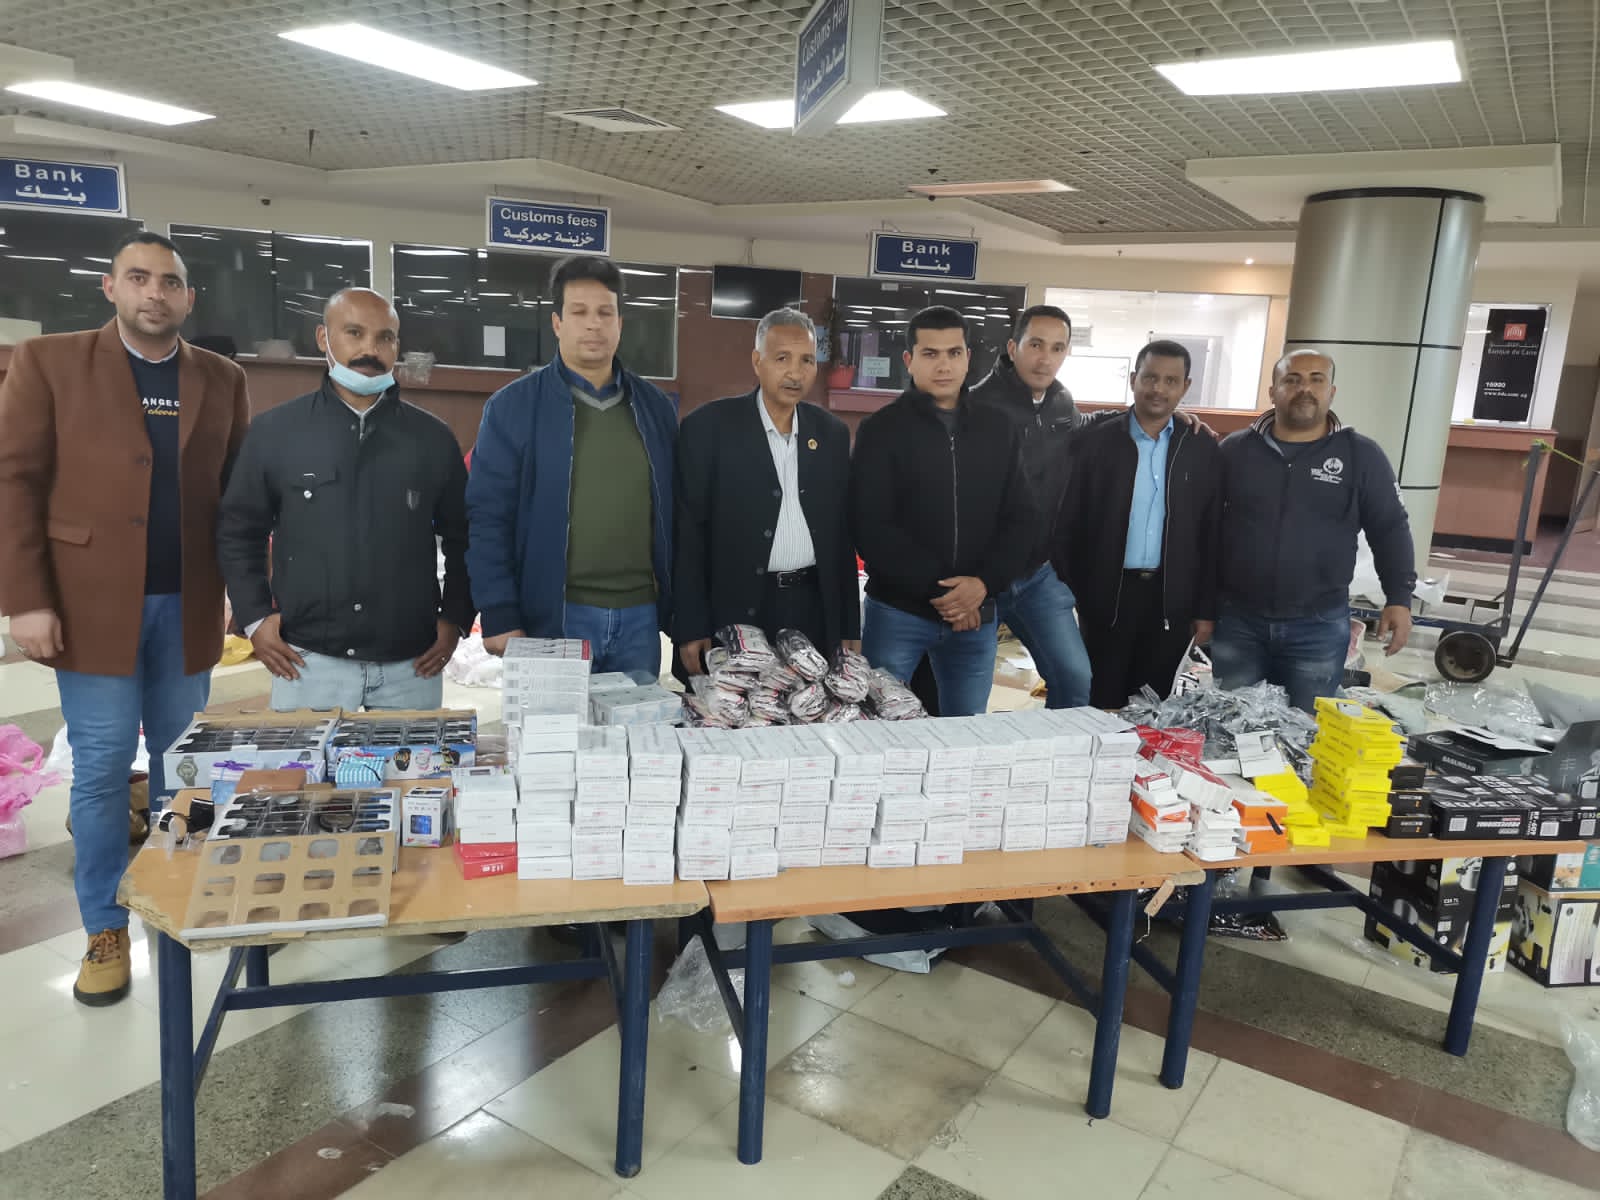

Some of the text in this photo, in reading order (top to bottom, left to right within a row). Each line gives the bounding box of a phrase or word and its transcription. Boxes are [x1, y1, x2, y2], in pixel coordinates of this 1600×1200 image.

[15, 163, 84, 183] Bank
[500, 207, 598, 228] Customs fees
[503, 226, 595, 247] خزينة جمركية
[902, 240, 951, 256] Bank
